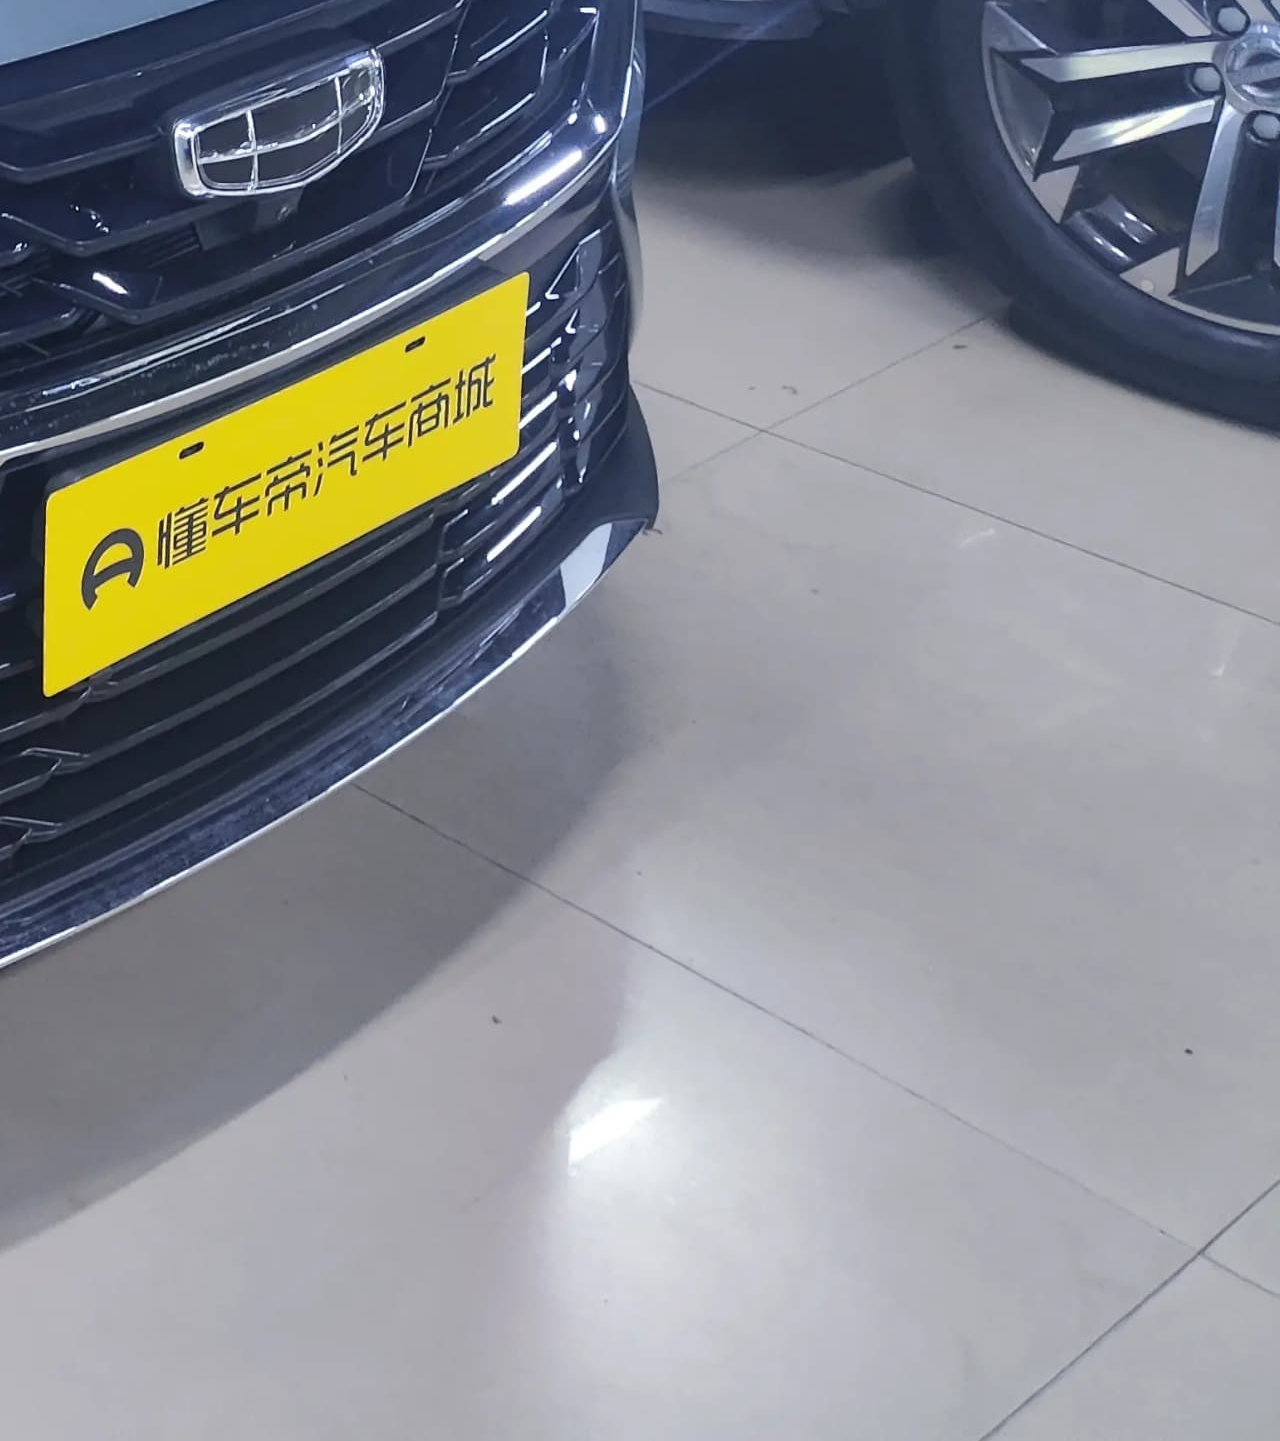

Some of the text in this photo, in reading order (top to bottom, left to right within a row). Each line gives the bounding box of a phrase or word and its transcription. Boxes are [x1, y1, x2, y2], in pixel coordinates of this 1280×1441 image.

[156, 353, 496, 569] 懂车帝汽车商城
